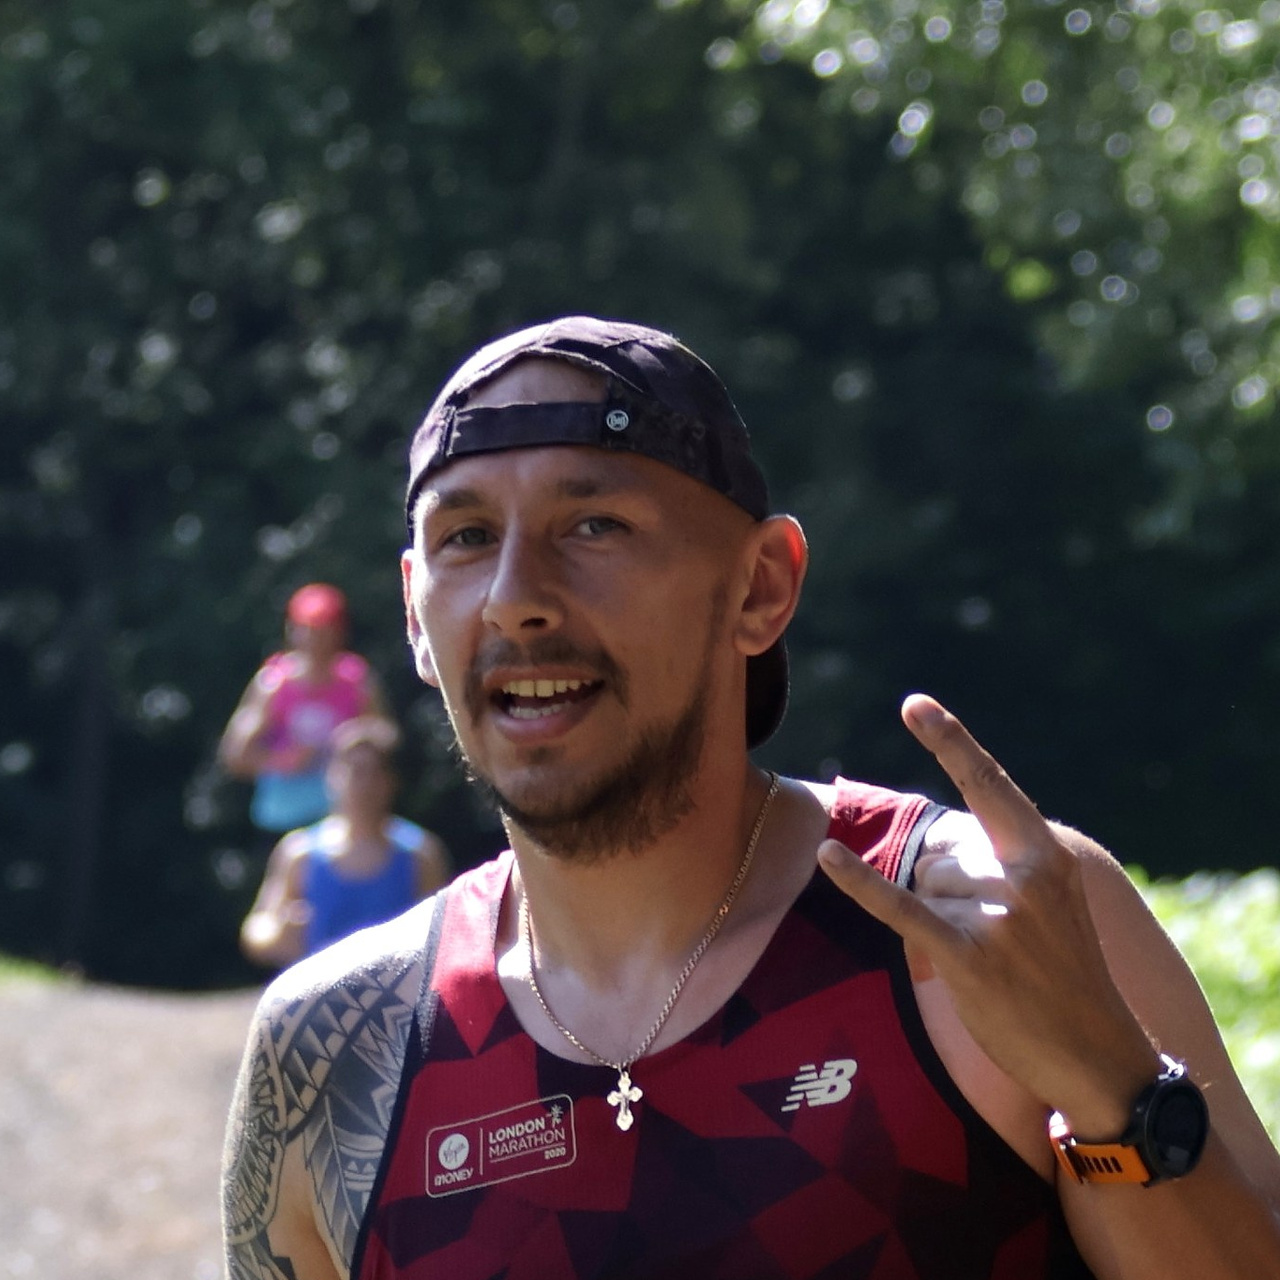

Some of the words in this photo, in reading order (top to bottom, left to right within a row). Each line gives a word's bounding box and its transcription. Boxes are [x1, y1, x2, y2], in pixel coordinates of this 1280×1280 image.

[489, 1117, 546, 1144] LONDON
[489, 1127, 566, 1159] MARATHON
[544, 1147, 566, 1159] 2020
